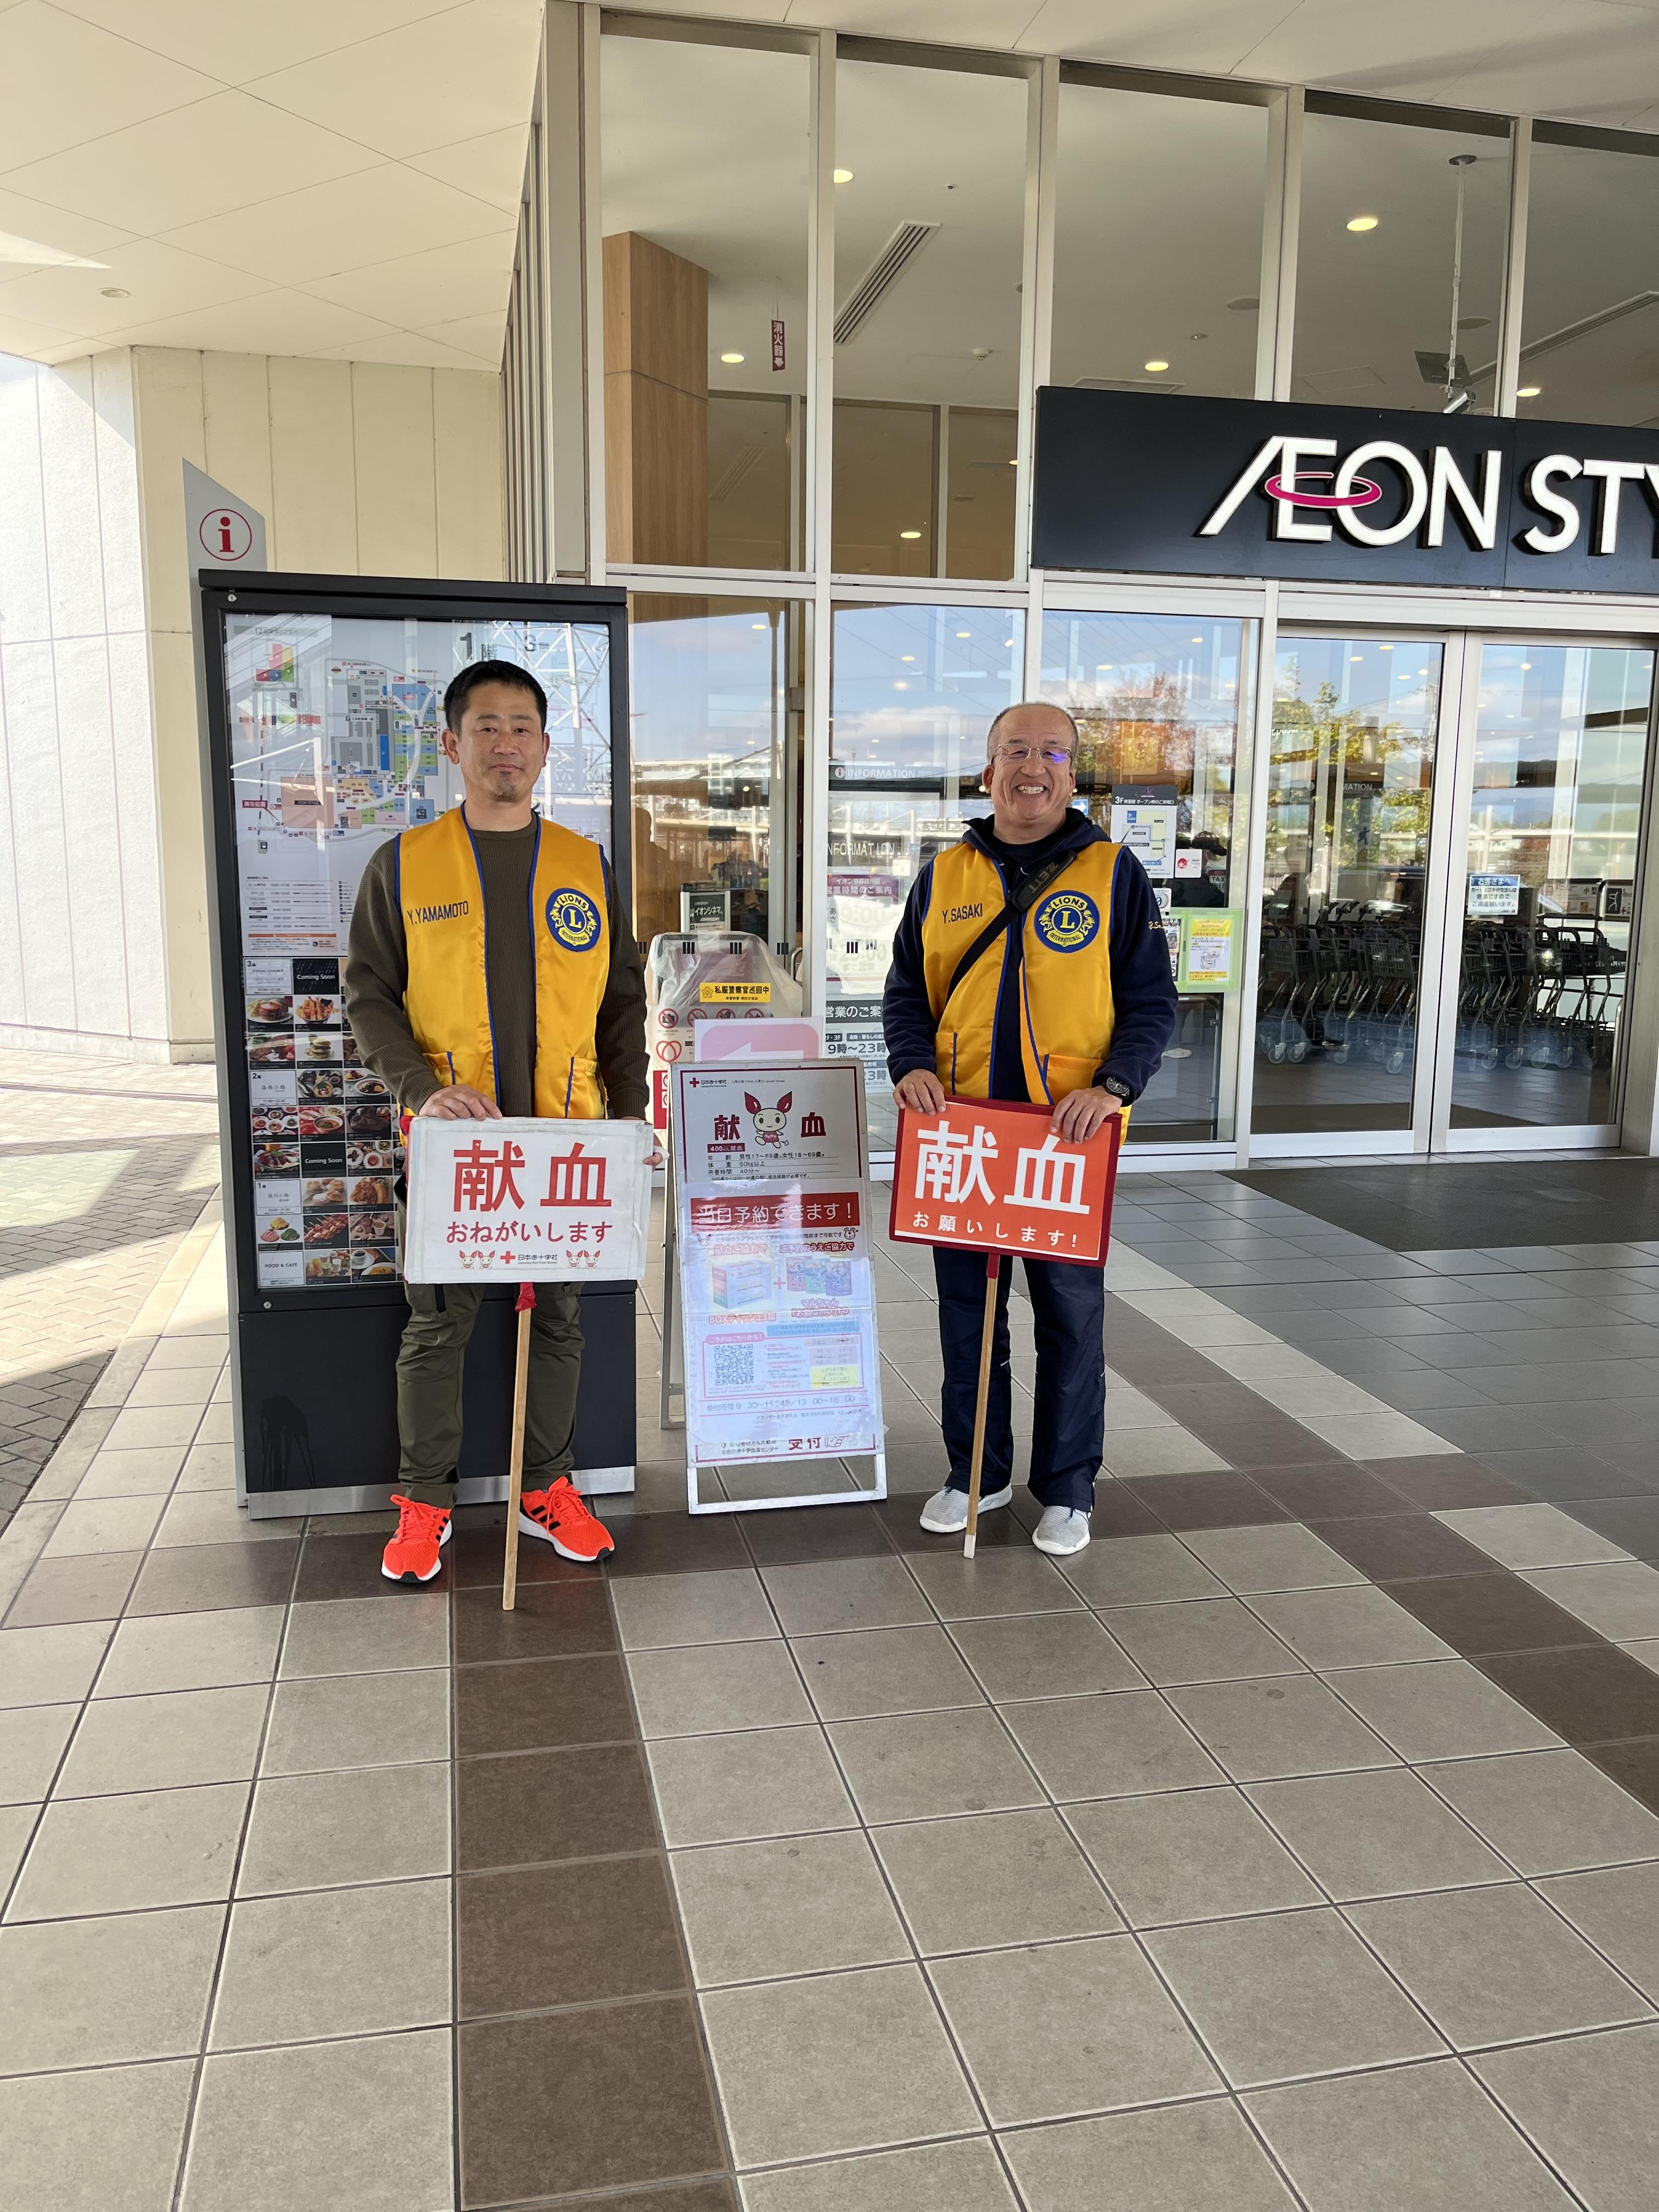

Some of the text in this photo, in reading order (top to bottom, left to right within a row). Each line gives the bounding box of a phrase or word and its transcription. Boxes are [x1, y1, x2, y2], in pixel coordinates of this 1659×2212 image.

[774, 322, 783, 356] 消火器
[848, 769, 915, 778] INFORMATION
[560, 895, 587, 909] LIONS
[1053, 897, 1085, 909] LIONS
[407, 900, 469, 926] Y.YAMAMOTO
[568, 909, 582, 928] L
[942, 902, 983, 924] Y.SASAKI
[1060, 911, 1075, 929] L
[561, 930, 587, 942] INTERNATIONAL
[1049, 932, 1081, 943] INTERNATIONAL
[715, 985, 769, 994] 私服警察官巡回中
[826, 1006, 883, 1018] 営業のご案
[828, 1042, 886, 1054] 9時～23時
[865, 1069, 887, 1080] 3時
[915, 1120, 1090, 1215] 献血
[453, 1139, 612, 1212] 献血
[698, 1203, 853, 1224] 当日予約できます！
[447, 1220, 613, 1243] おねがいします
[714, 1242, 854, 1255] 献血ご協力で ご予約のうえご協力で
[802, 1298, 839, 1307] マルちゃん
[788, 1437, 821, 1451] 受付
[722, 1447, 778, 1455] 京都府赤十字血液センター
